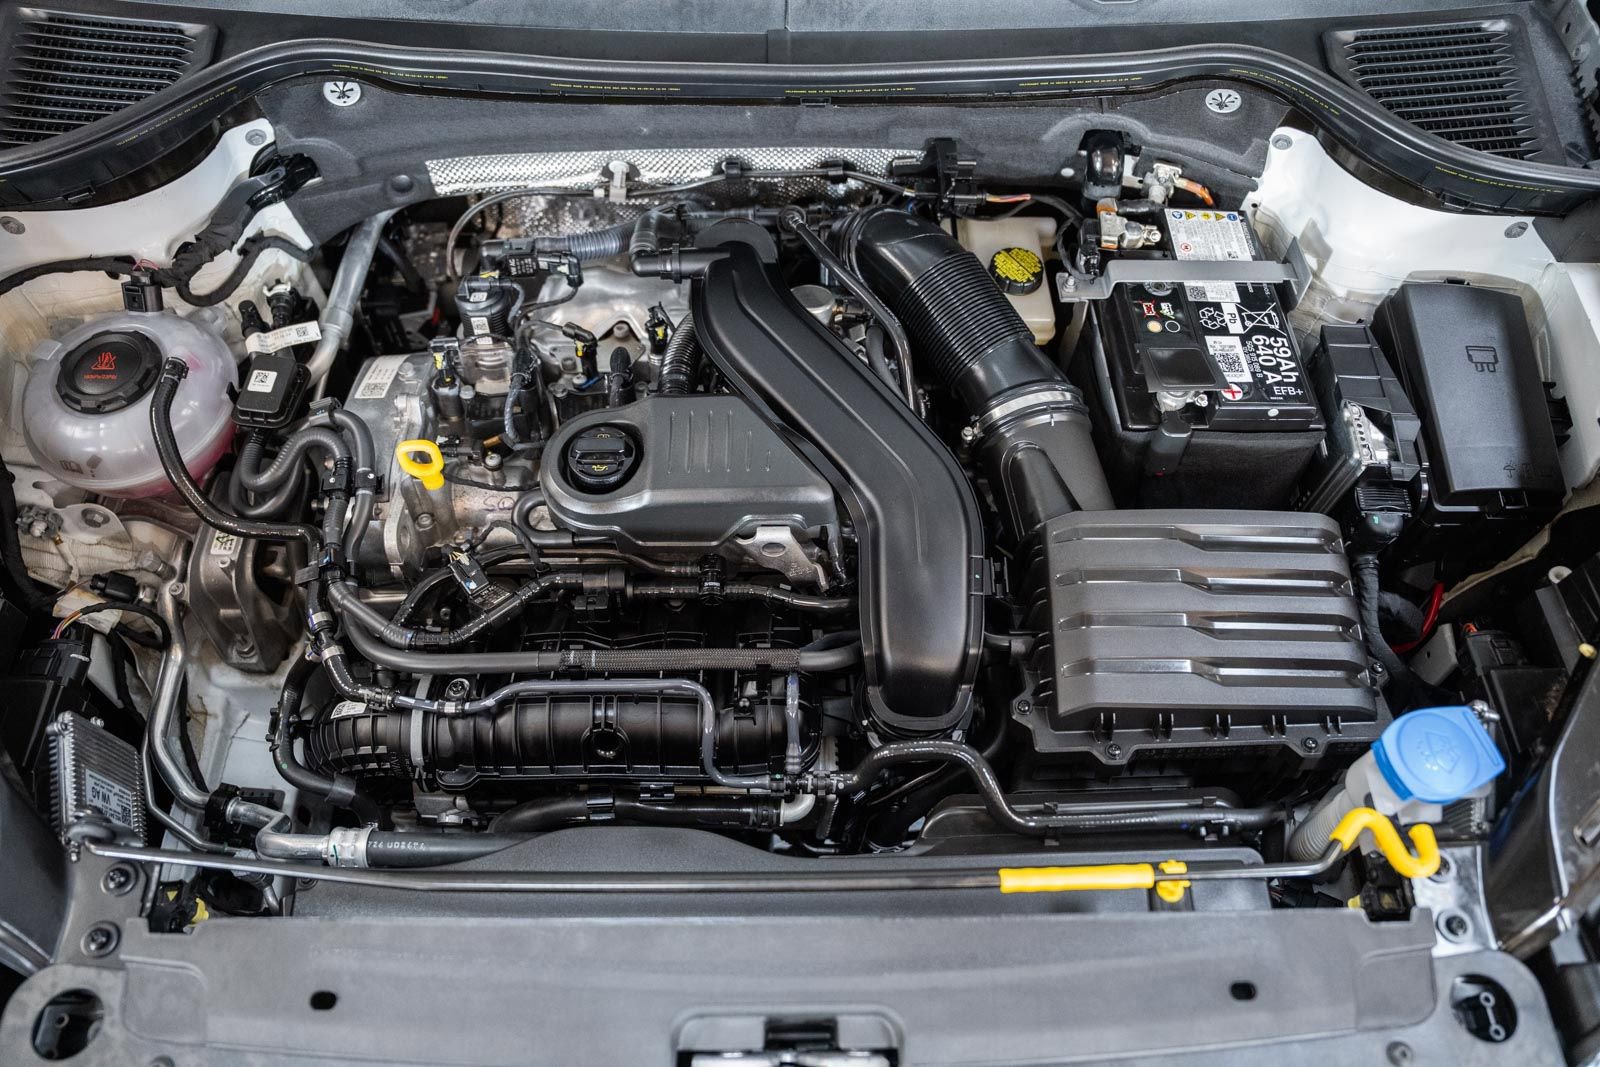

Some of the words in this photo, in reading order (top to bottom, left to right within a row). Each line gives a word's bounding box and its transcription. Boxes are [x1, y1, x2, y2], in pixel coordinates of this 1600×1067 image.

[1226, 312, 1237, 324] Pb
[1252, 335, 1277, 367] 640
[1270, 336, 1299, 382] 59Ah
[1262, 370, 1282, 384] A
[1273, 386, 1303, 396] EFB+
[91, 786, 100, 800] AG
[101, 791, 111, 806] VW
